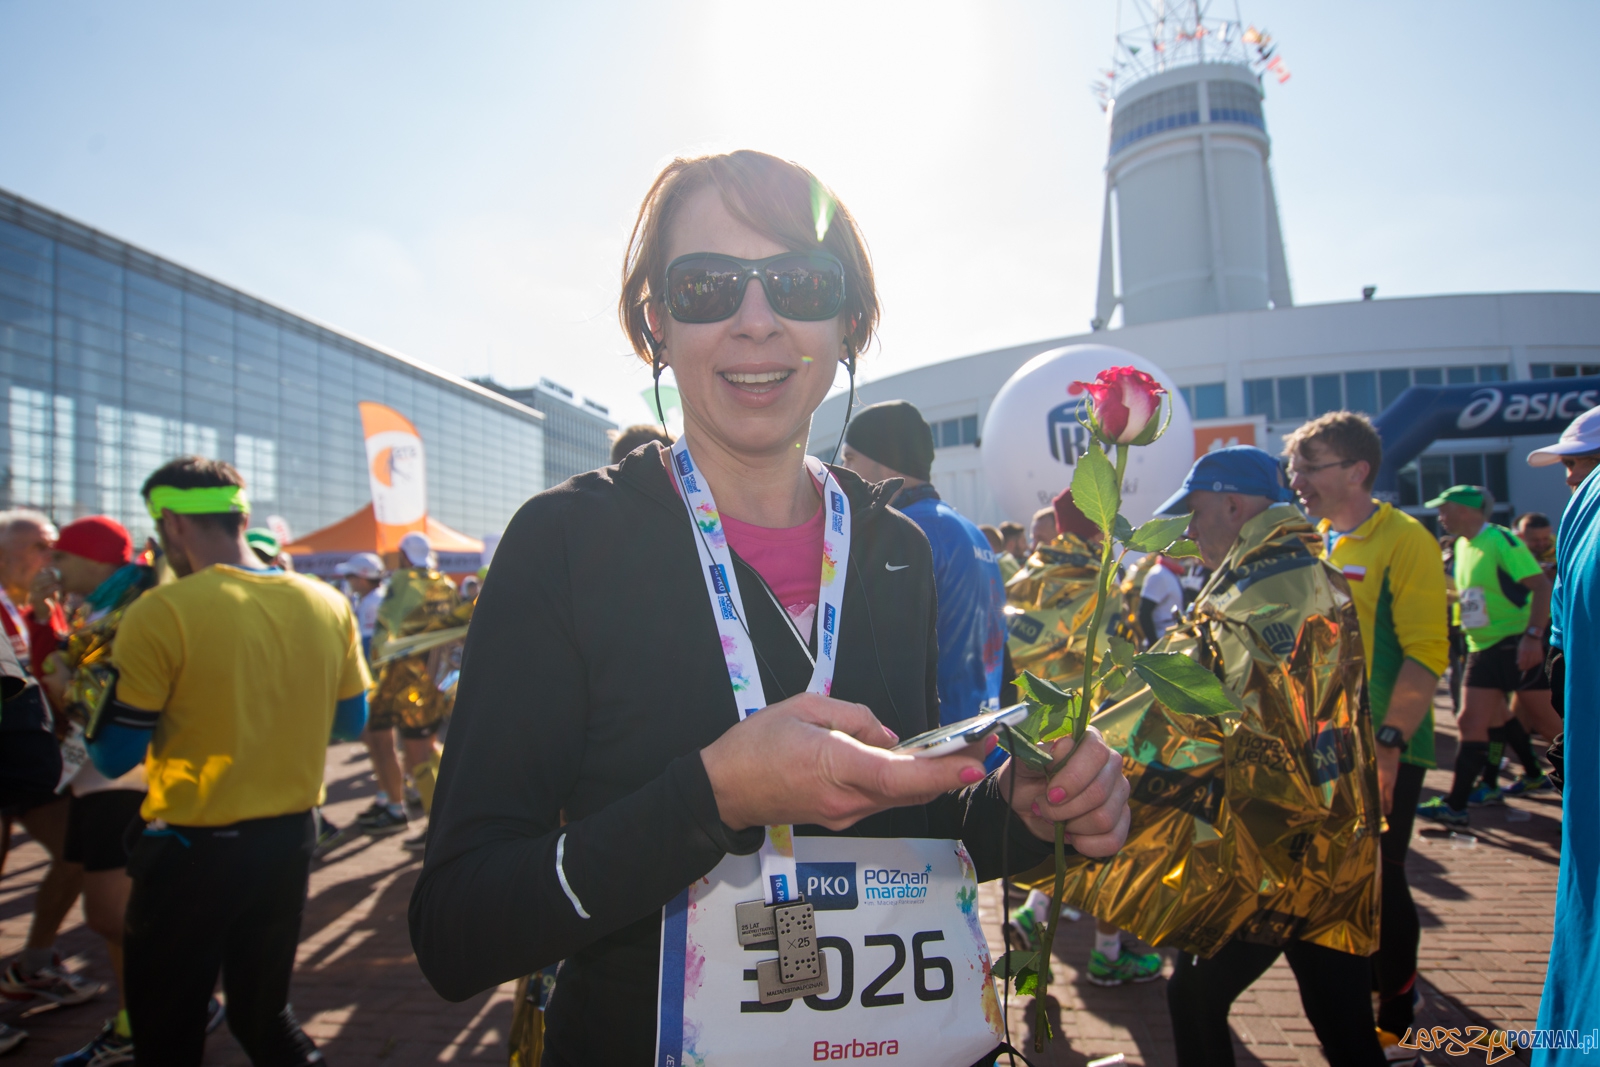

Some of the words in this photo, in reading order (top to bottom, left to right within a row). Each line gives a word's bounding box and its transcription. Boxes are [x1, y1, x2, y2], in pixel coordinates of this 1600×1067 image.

[775, 877, 784, 892] 16.
[807, 876, 850, 896] PKO
[866, 884, 927, 900] maraton
[750, 922, 759, 930] LAT
[813, 1038, 899, 1061] Barbara
